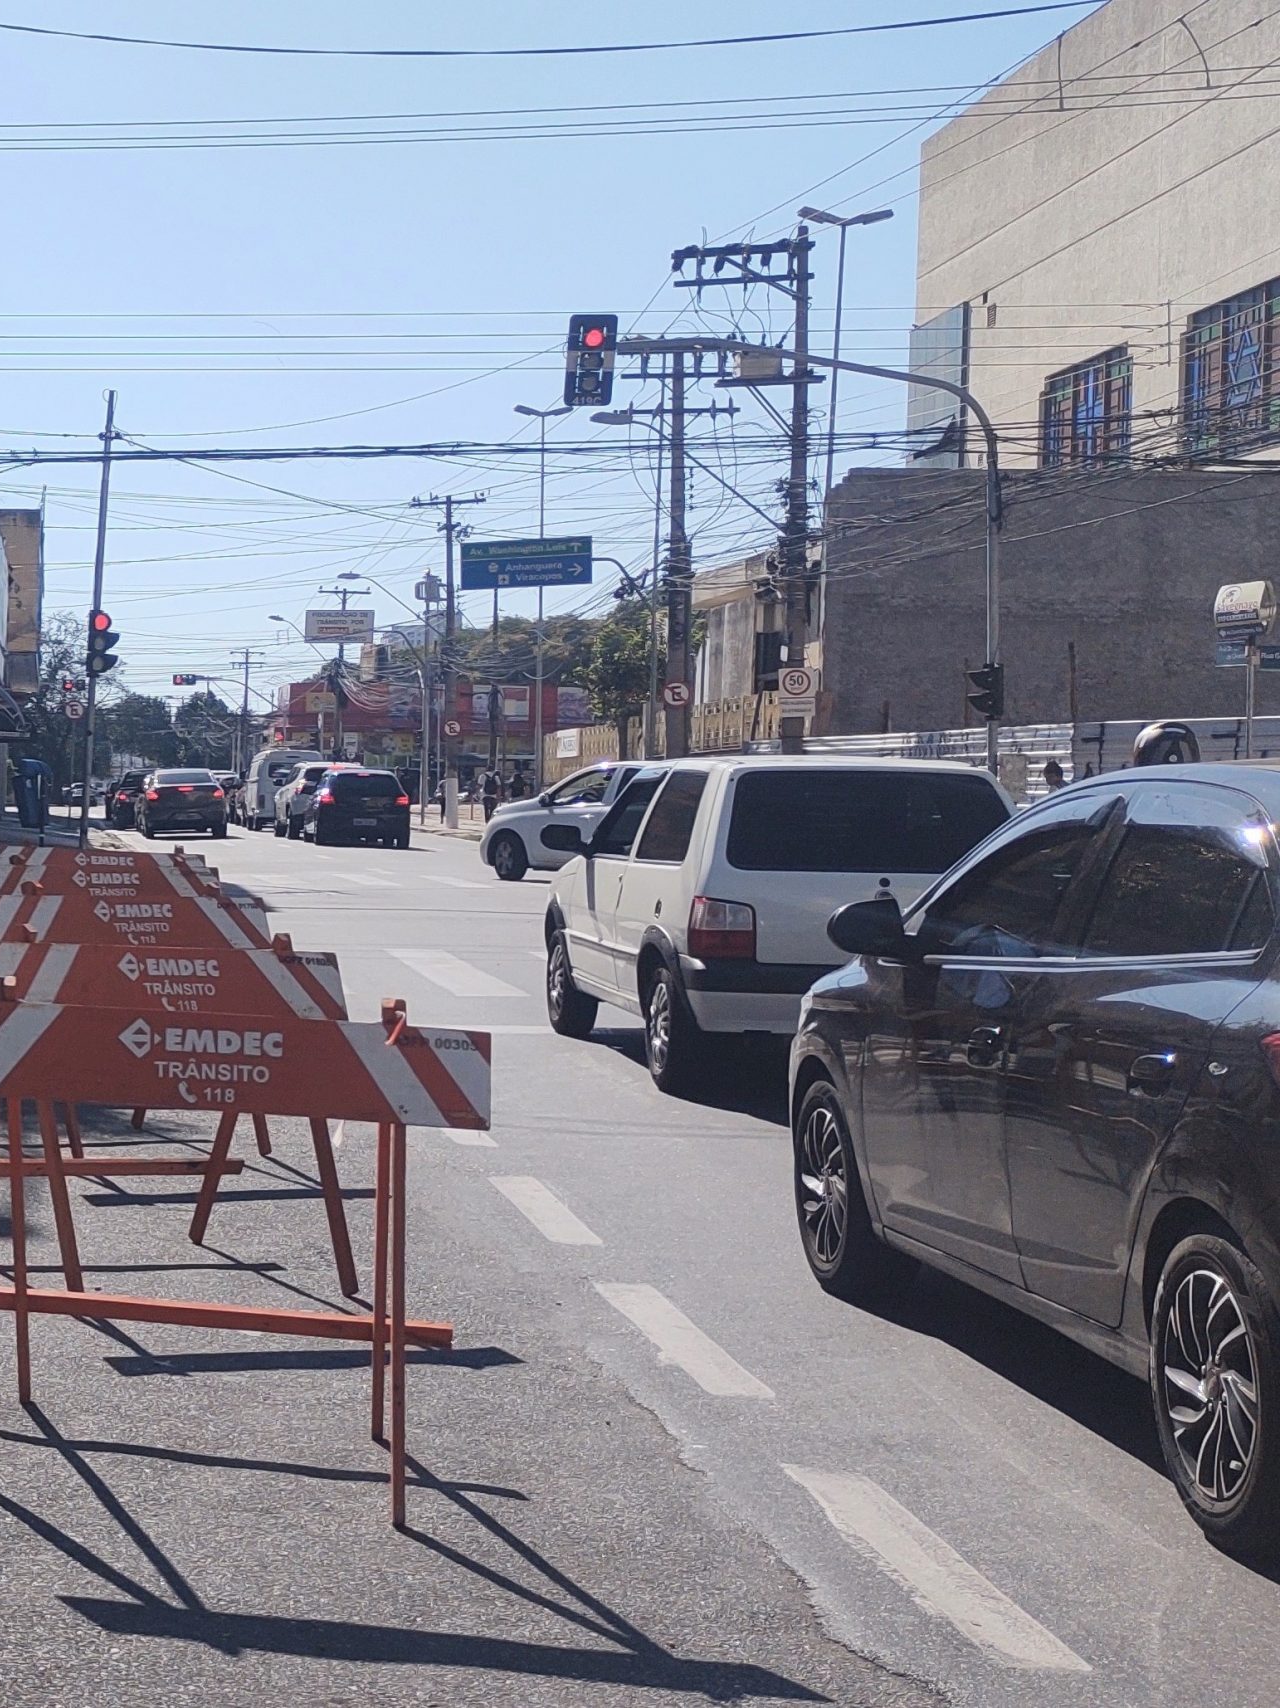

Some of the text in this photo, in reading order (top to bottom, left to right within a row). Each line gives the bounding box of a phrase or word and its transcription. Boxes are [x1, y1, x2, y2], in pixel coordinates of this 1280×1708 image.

[505, 562, 562, 571] Anhanguera
[516, 573, 563, 582] Viracopos
[789, 675, 804, 686] 50
[91, 855, 135, 866] EMDEC
[91, 872, 140, 884] EMDEC
[88, 886, 136, 896] TRÂNSITO
[116, 904, 173, 918] EMDEC
[114, 920, 169, 932] TRÂNSITO
[141, 935, 156, 944] 118
[145, 958, 220, 977] EMDEC
[143, 979, 216, 996] TRÂNSITO
[177, 1000, 198, 1011] 118
[165, 1027, 283, 1057] EMDEC
[154, 1058, 270, 1083] TRÂNSITO
[204, 1087, 235, 1103] 118
